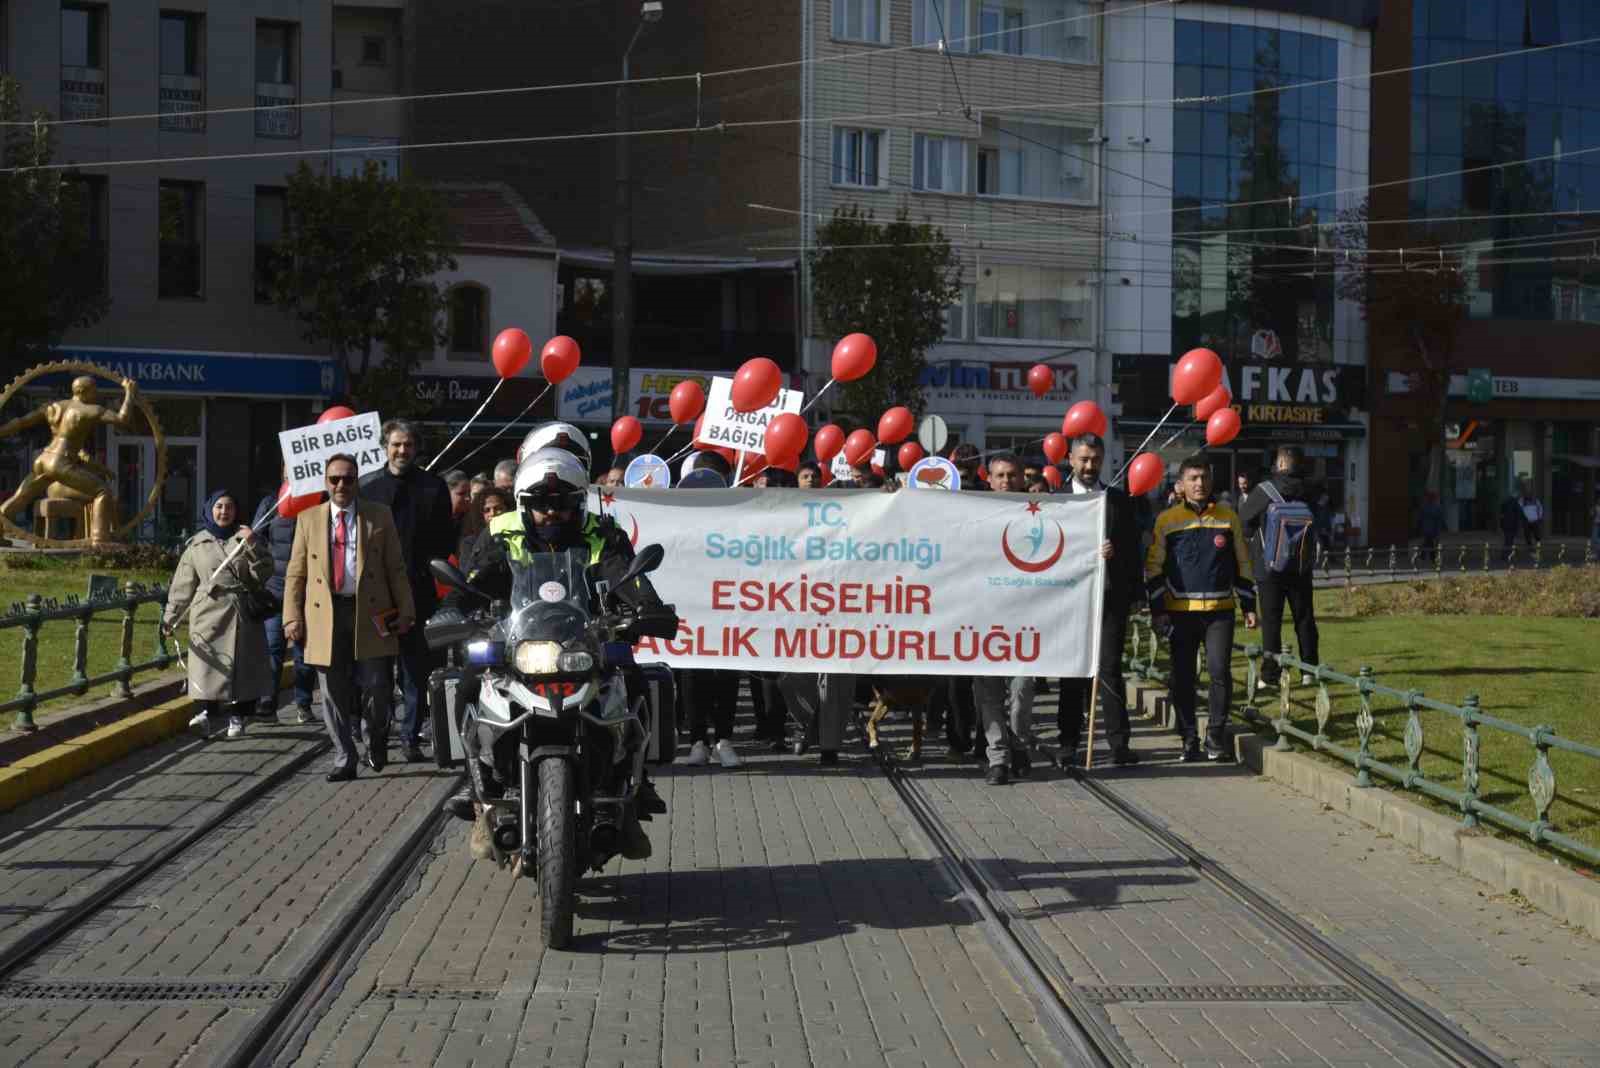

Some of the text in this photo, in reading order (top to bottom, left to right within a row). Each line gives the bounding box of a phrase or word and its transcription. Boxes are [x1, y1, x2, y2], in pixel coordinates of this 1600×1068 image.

[96, 360, 206, 383] HALKBANK
[448, 380, 480, 401] Pazar
[1494, 380, 1519, 393] TEB
[724, 406, 775, 427] ORGA
[291, 424, 373, 454] BİR BAĞIŞ
[293, 460, 323, 480] BİR
[802, 502, 847, 527] T.C.
[706, 533, 941, 569] Sağlık Bakanlığı
[711, 574, 931, 616] ESKİŞEHİR
[632, 620, 1041, 660] AĞLIK MÜDÜRLÜĞÜ
